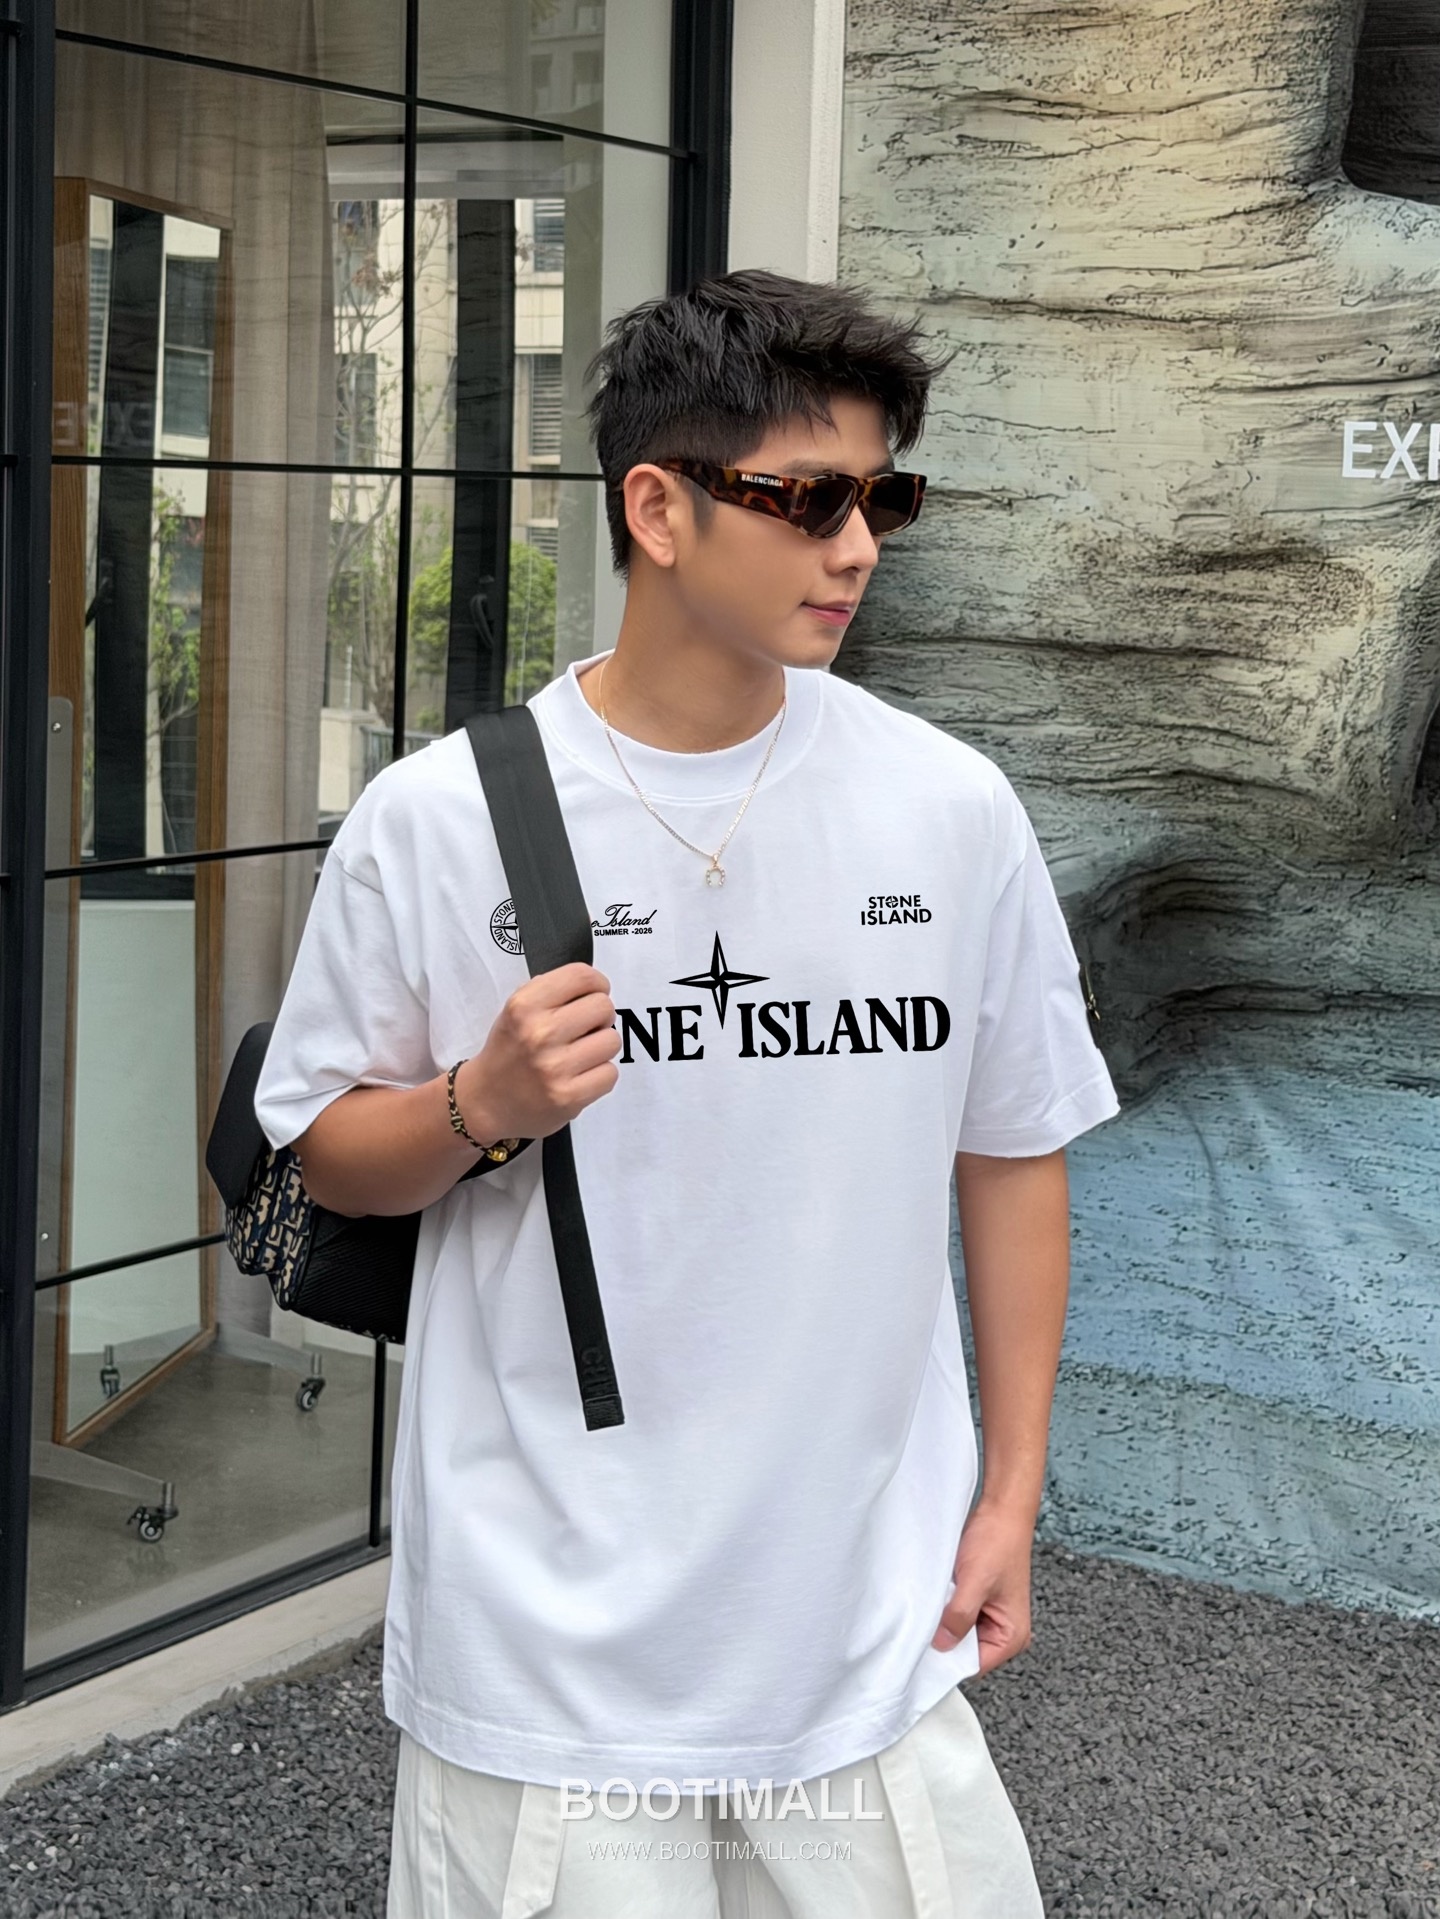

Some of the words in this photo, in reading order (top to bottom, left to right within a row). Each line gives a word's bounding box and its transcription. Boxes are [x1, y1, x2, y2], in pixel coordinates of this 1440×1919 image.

[741, 473, 784, 487] BALENCIAGA
[868, 894, 921, 909] STONE
[860, 908, 932, 926] ISLAND
[494, 928, 517, 951] ISLAND
[594, 928, 629, 936] SUMMER
[611, 1005, 704, 1064] NE
[737, 996, 951, 1058] ISLAND
